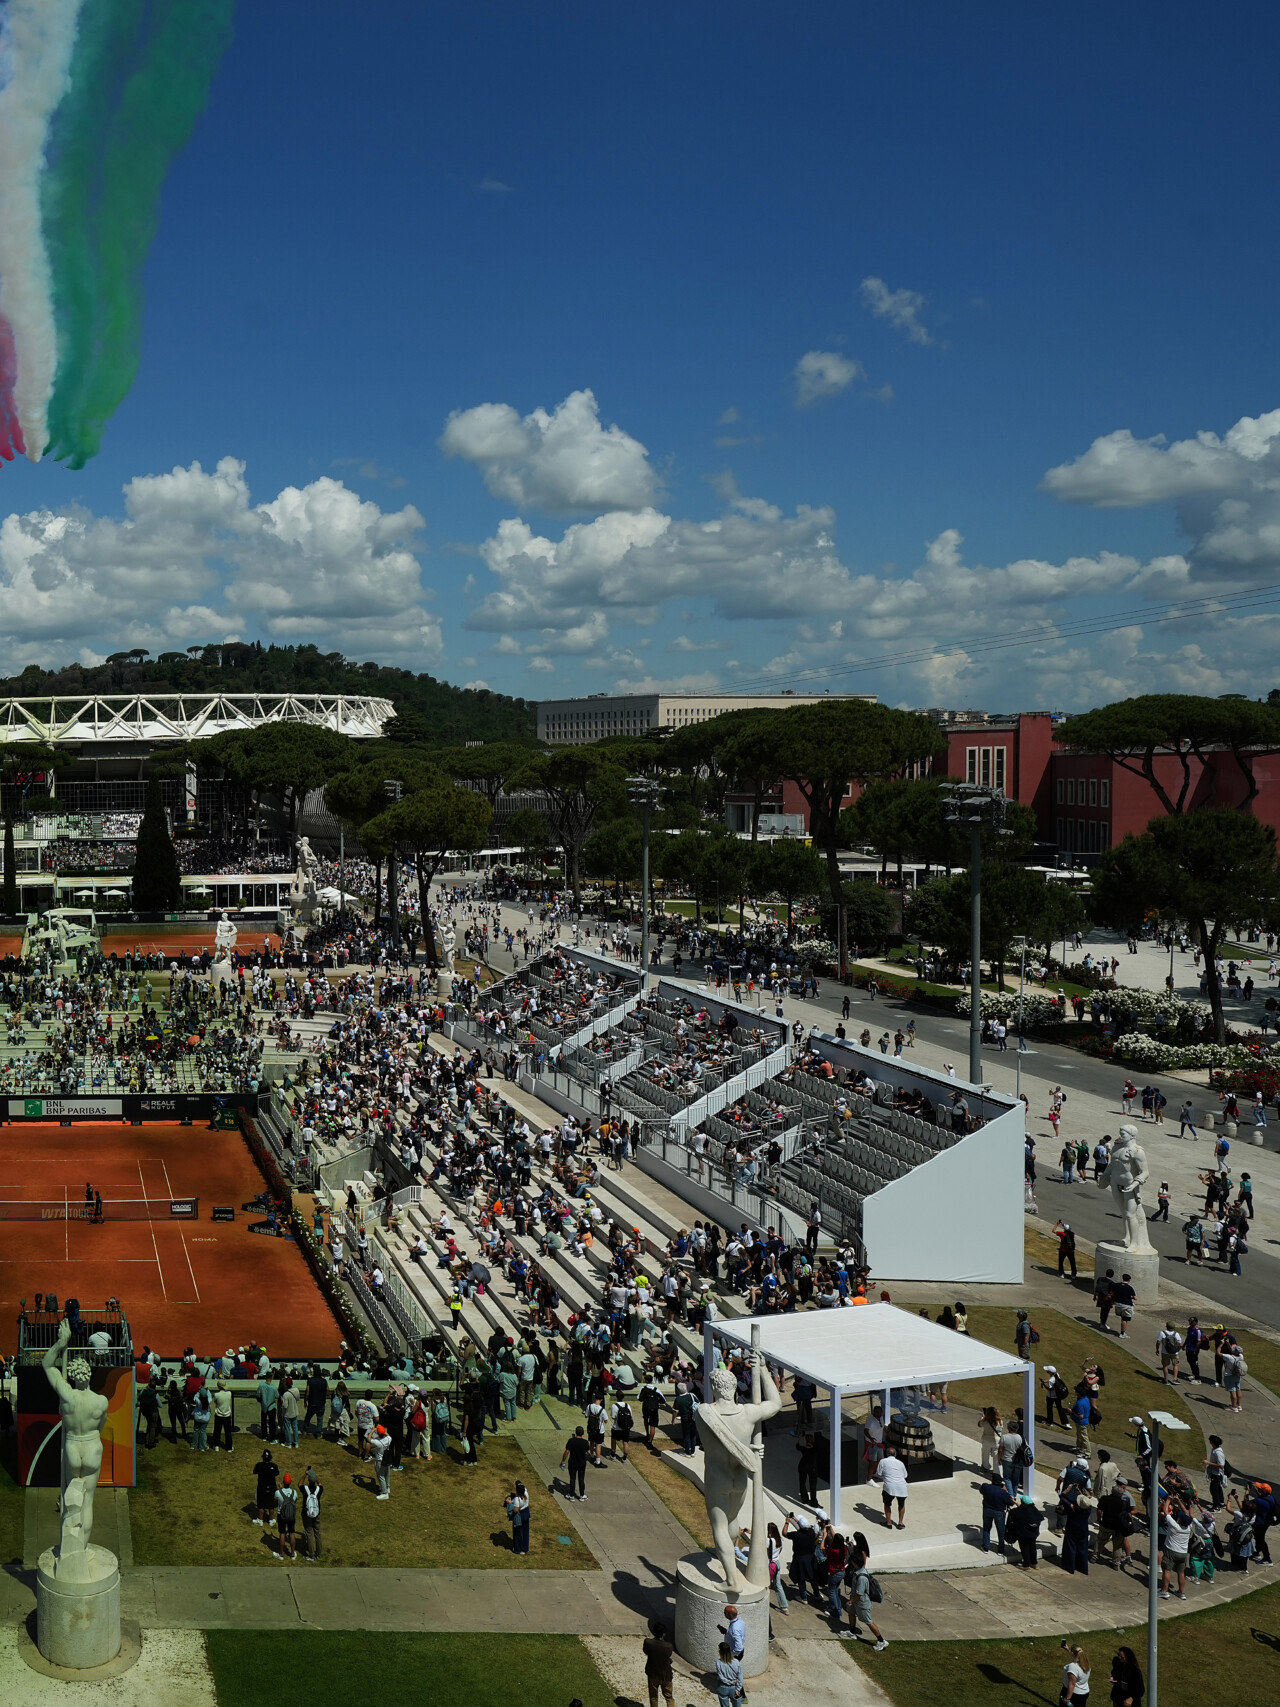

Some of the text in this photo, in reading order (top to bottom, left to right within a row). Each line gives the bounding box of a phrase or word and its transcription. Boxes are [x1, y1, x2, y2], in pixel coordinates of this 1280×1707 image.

[68, 1107, 107, 1115] PARIBAS
[41, 1208, 90, 1219] WTA TOUR
[252, 1207, 268, 1215] emu
[260, 1228, 277, 1236] emu
